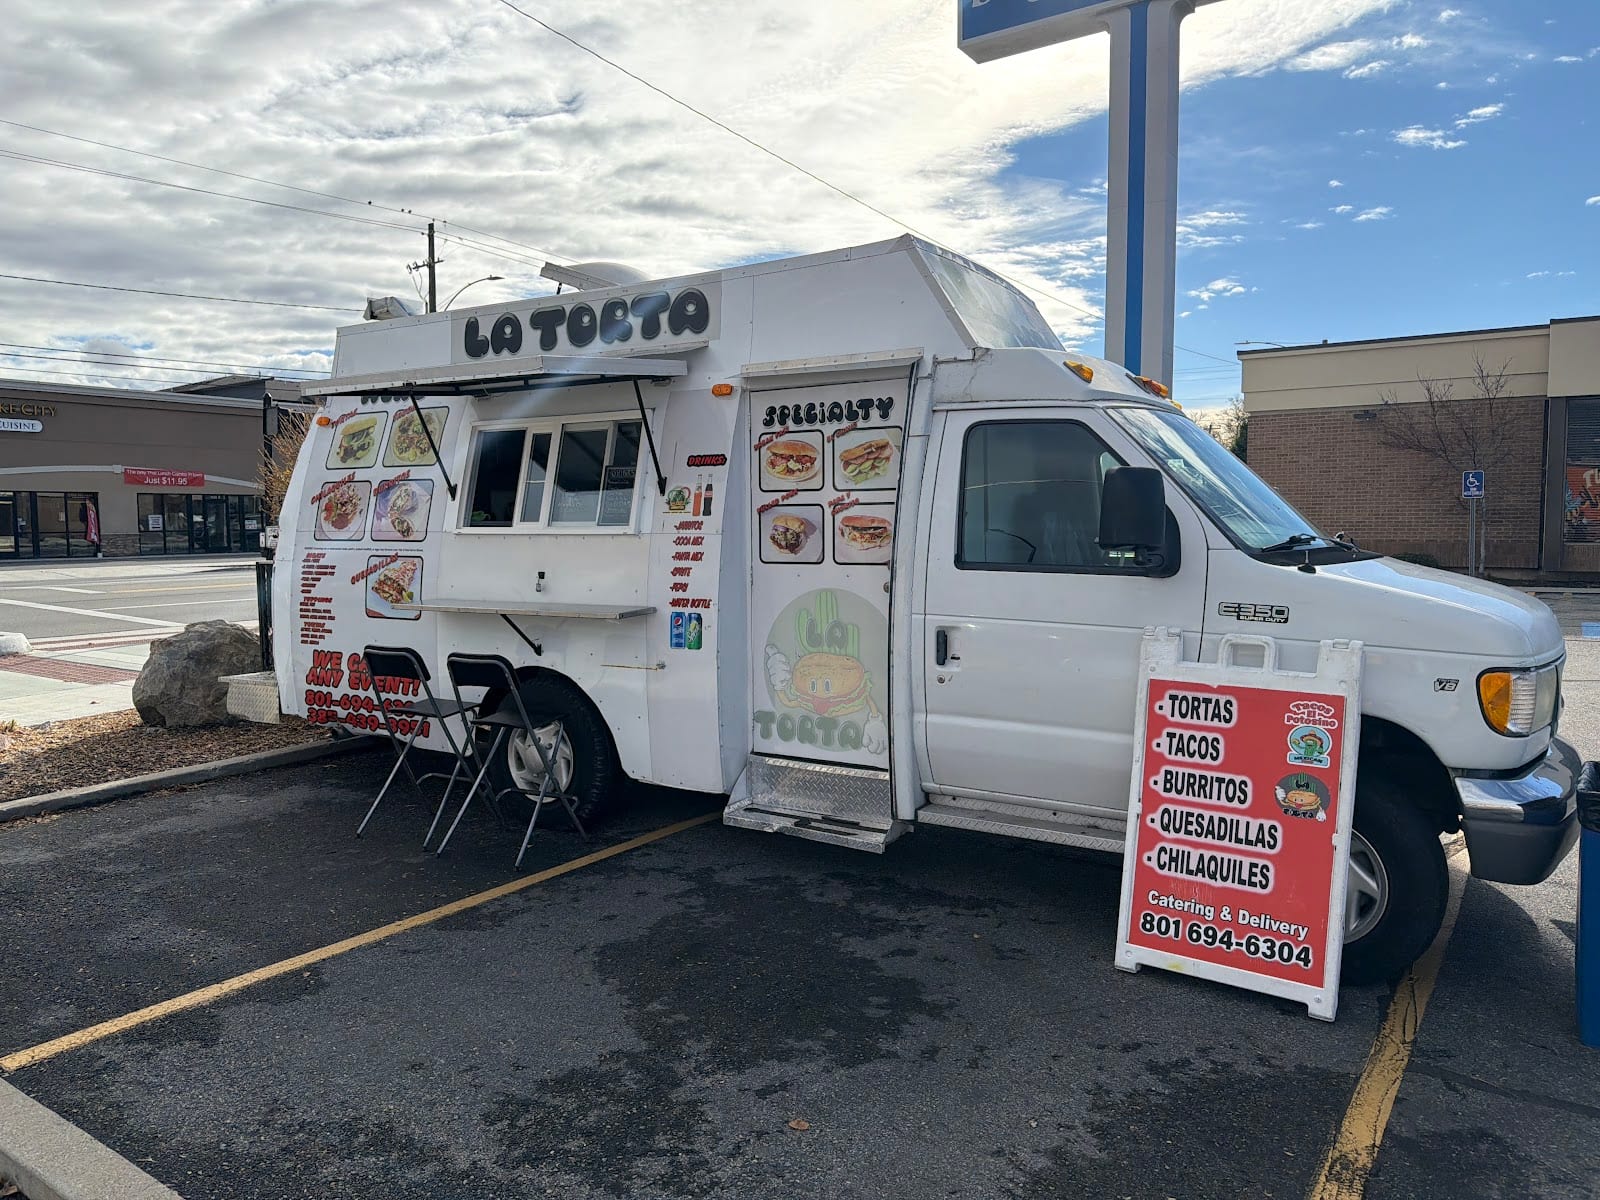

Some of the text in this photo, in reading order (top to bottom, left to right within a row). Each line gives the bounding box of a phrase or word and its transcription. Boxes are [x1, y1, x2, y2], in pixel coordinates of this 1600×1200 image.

[464, 287, 710, 358] LA TORTA
[21, 402, 57, 417] CITY
[350, 551, 399, 585] QUESADILLAS
[806, 618, 847, 650] LA
[313, 649, 343, 669] WE
[306, 667, 344, 688] ANY
[1168, 694, 1233, 724] TORTAS
[1291, 701, 1334, 716] Tacos
[1306, 709, 1317, 719] El
[754, 710, 863, 751] TORTA
[1166, 731, 1220, 761] TACOS
[1163, 769, 1248, 805] BURRITOS
[1160, 807, 1278, 850] QUESADILLAS
[1157, 846, 1270, 890] CHILAQUILES
[1148, 890, 1309, 941] Catering & Delivery
[1141, 912, 1312, 968] 801 694-6304
